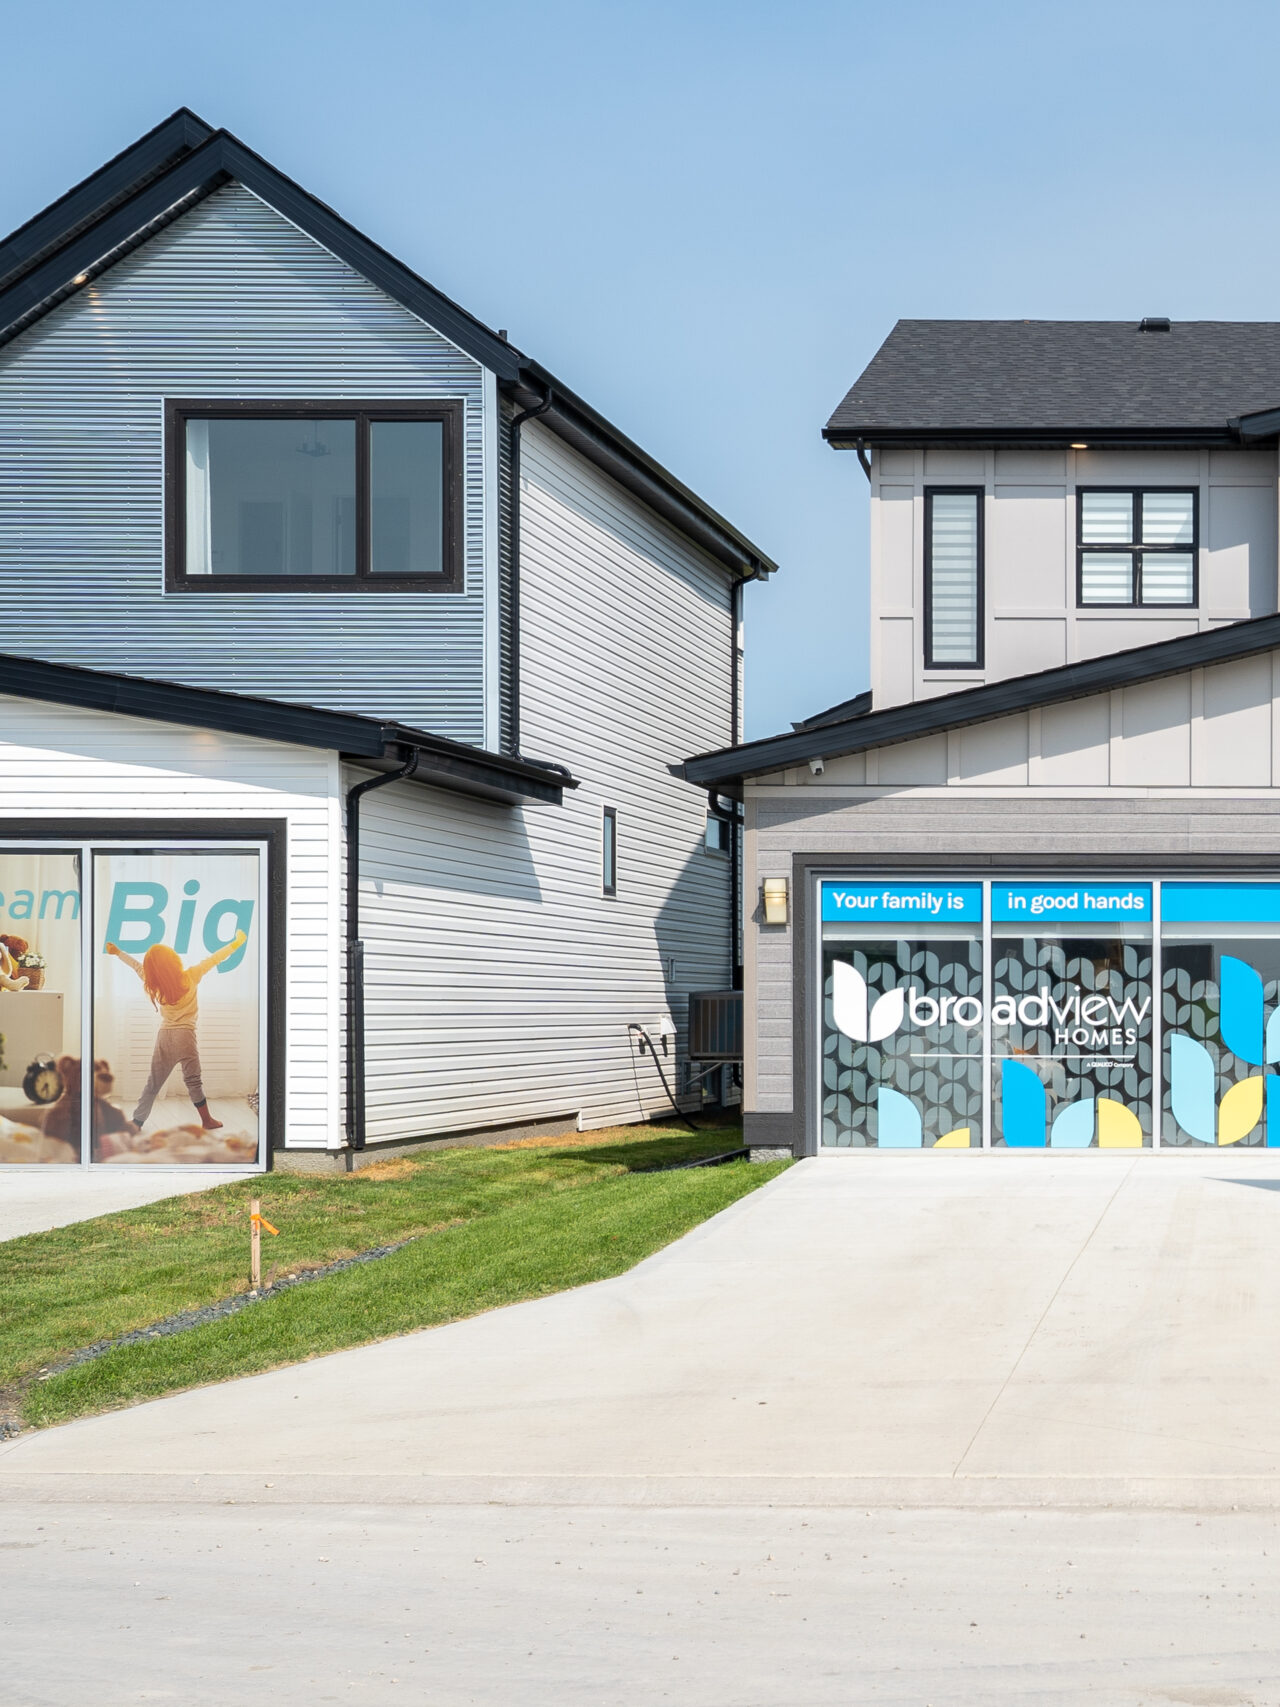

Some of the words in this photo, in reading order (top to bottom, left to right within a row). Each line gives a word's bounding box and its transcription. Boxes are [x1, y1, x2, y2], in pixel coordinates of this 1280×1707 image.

[833, 892, 878, 909] Your
[882, 892, 943, 914] family
[947, 892, 964, 909] is
[1008, 892, 1026, 909] in
[1030, 892, 1078, 914] good
[1084, 892, 1145, 910] hands
[0, 889, 80, 920] am
[102, 879, 255, 974] Big
[909, 985, 1151, 1027] broadview
[1054, 1028, 1136, 1045] HOMES
